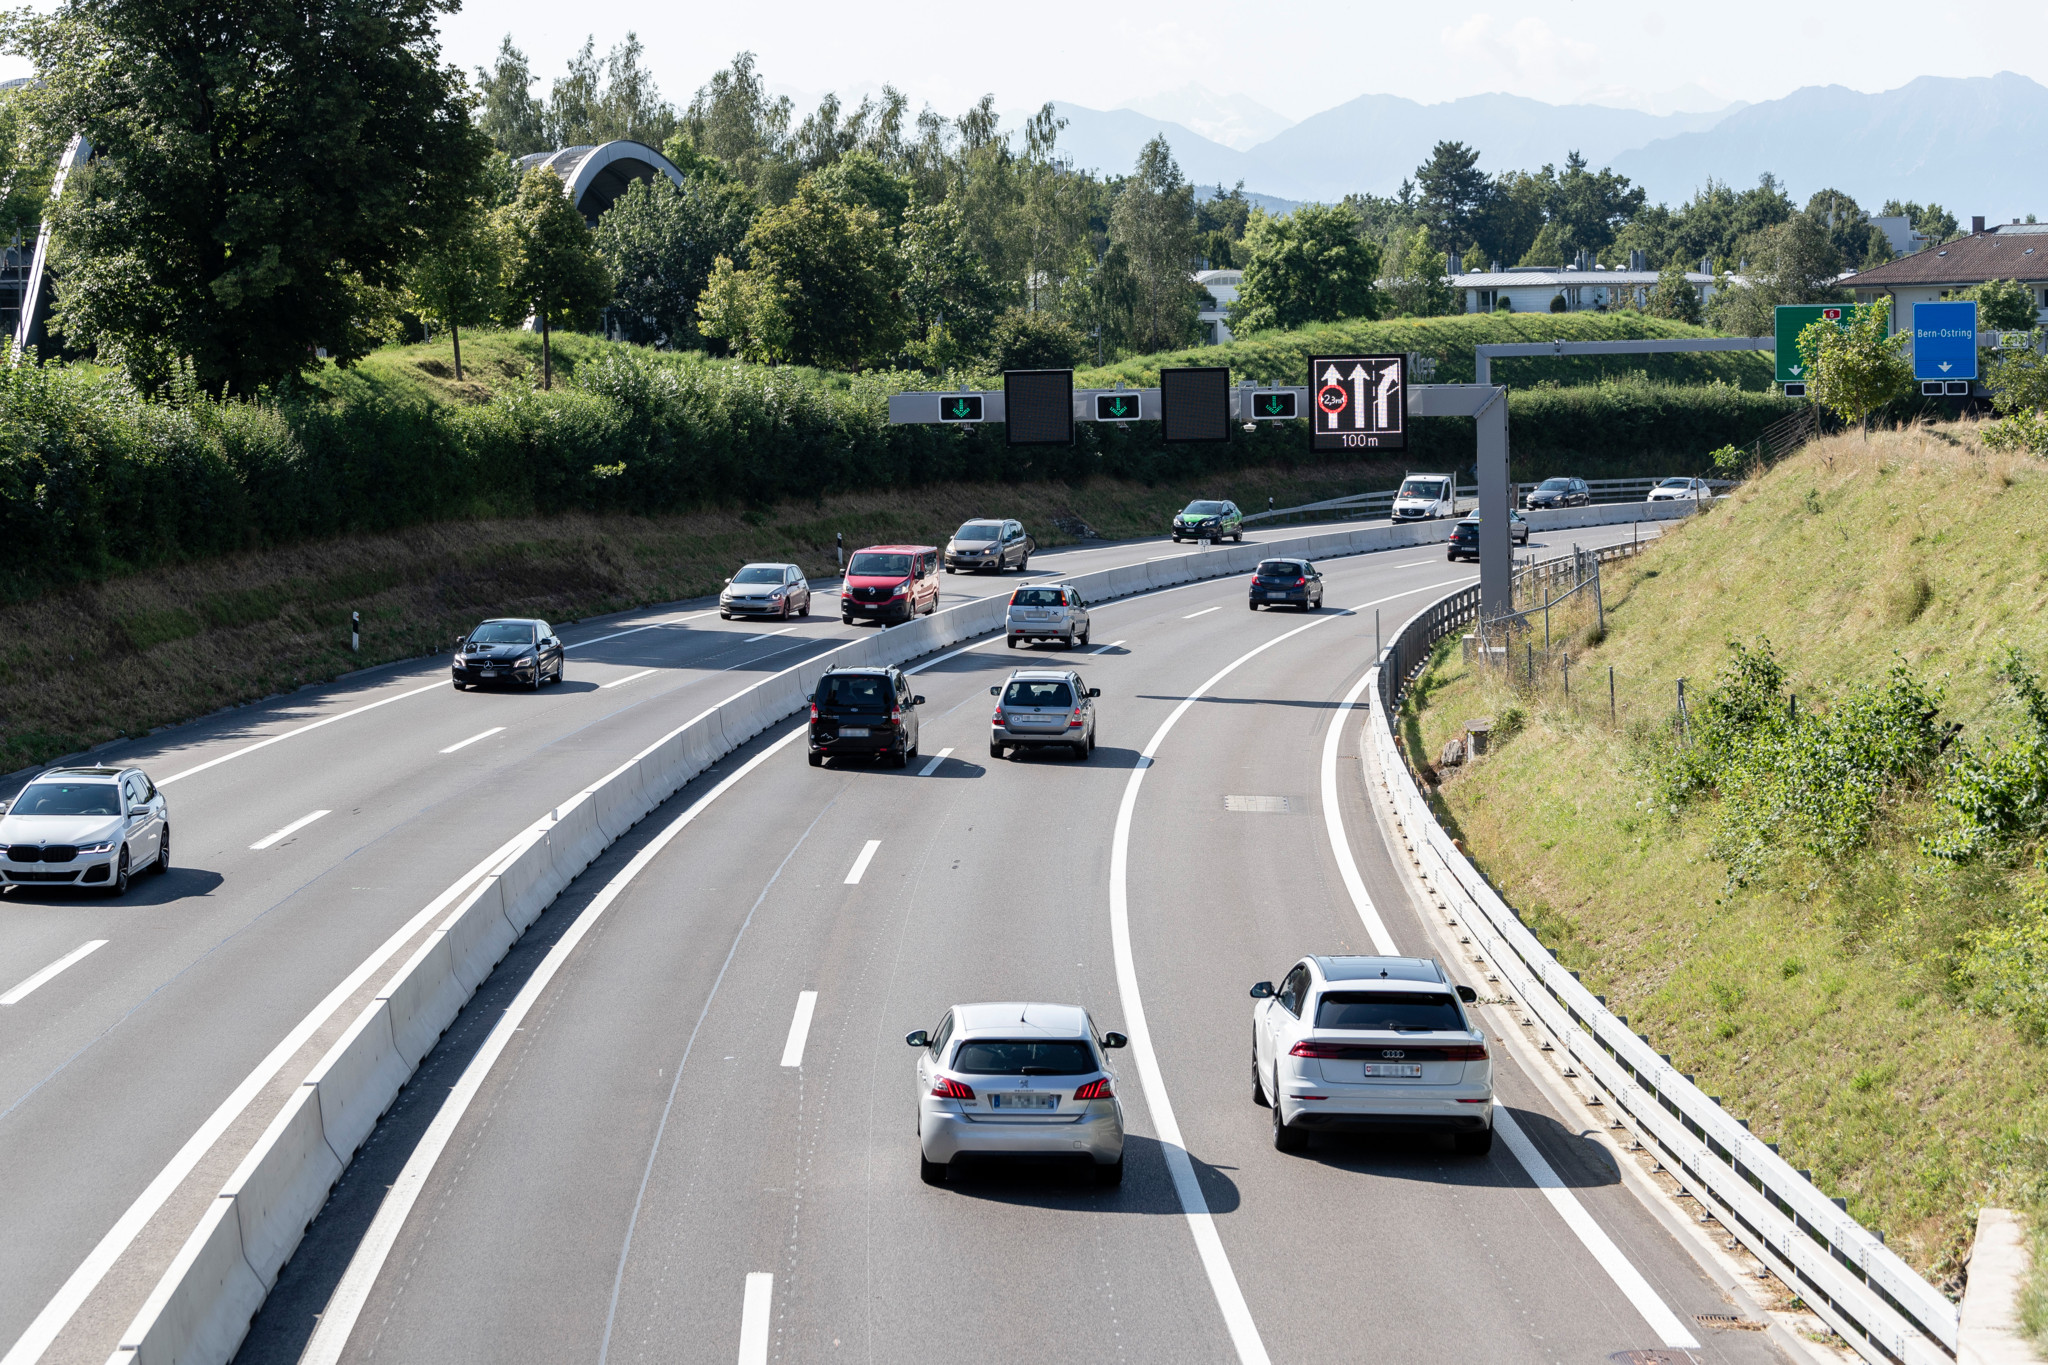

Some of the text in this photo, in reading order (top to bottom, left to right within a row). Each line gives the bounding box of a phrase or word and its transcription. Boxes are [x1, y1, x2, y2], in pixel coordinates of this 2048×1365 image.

[1829, 310, 1835, 318] 6
[1917, 328, 1972, 340] Bern-Ostring
[1407, 352, 1435, 375] Klee
[1324, 394, 1342, 405] 2,3m
